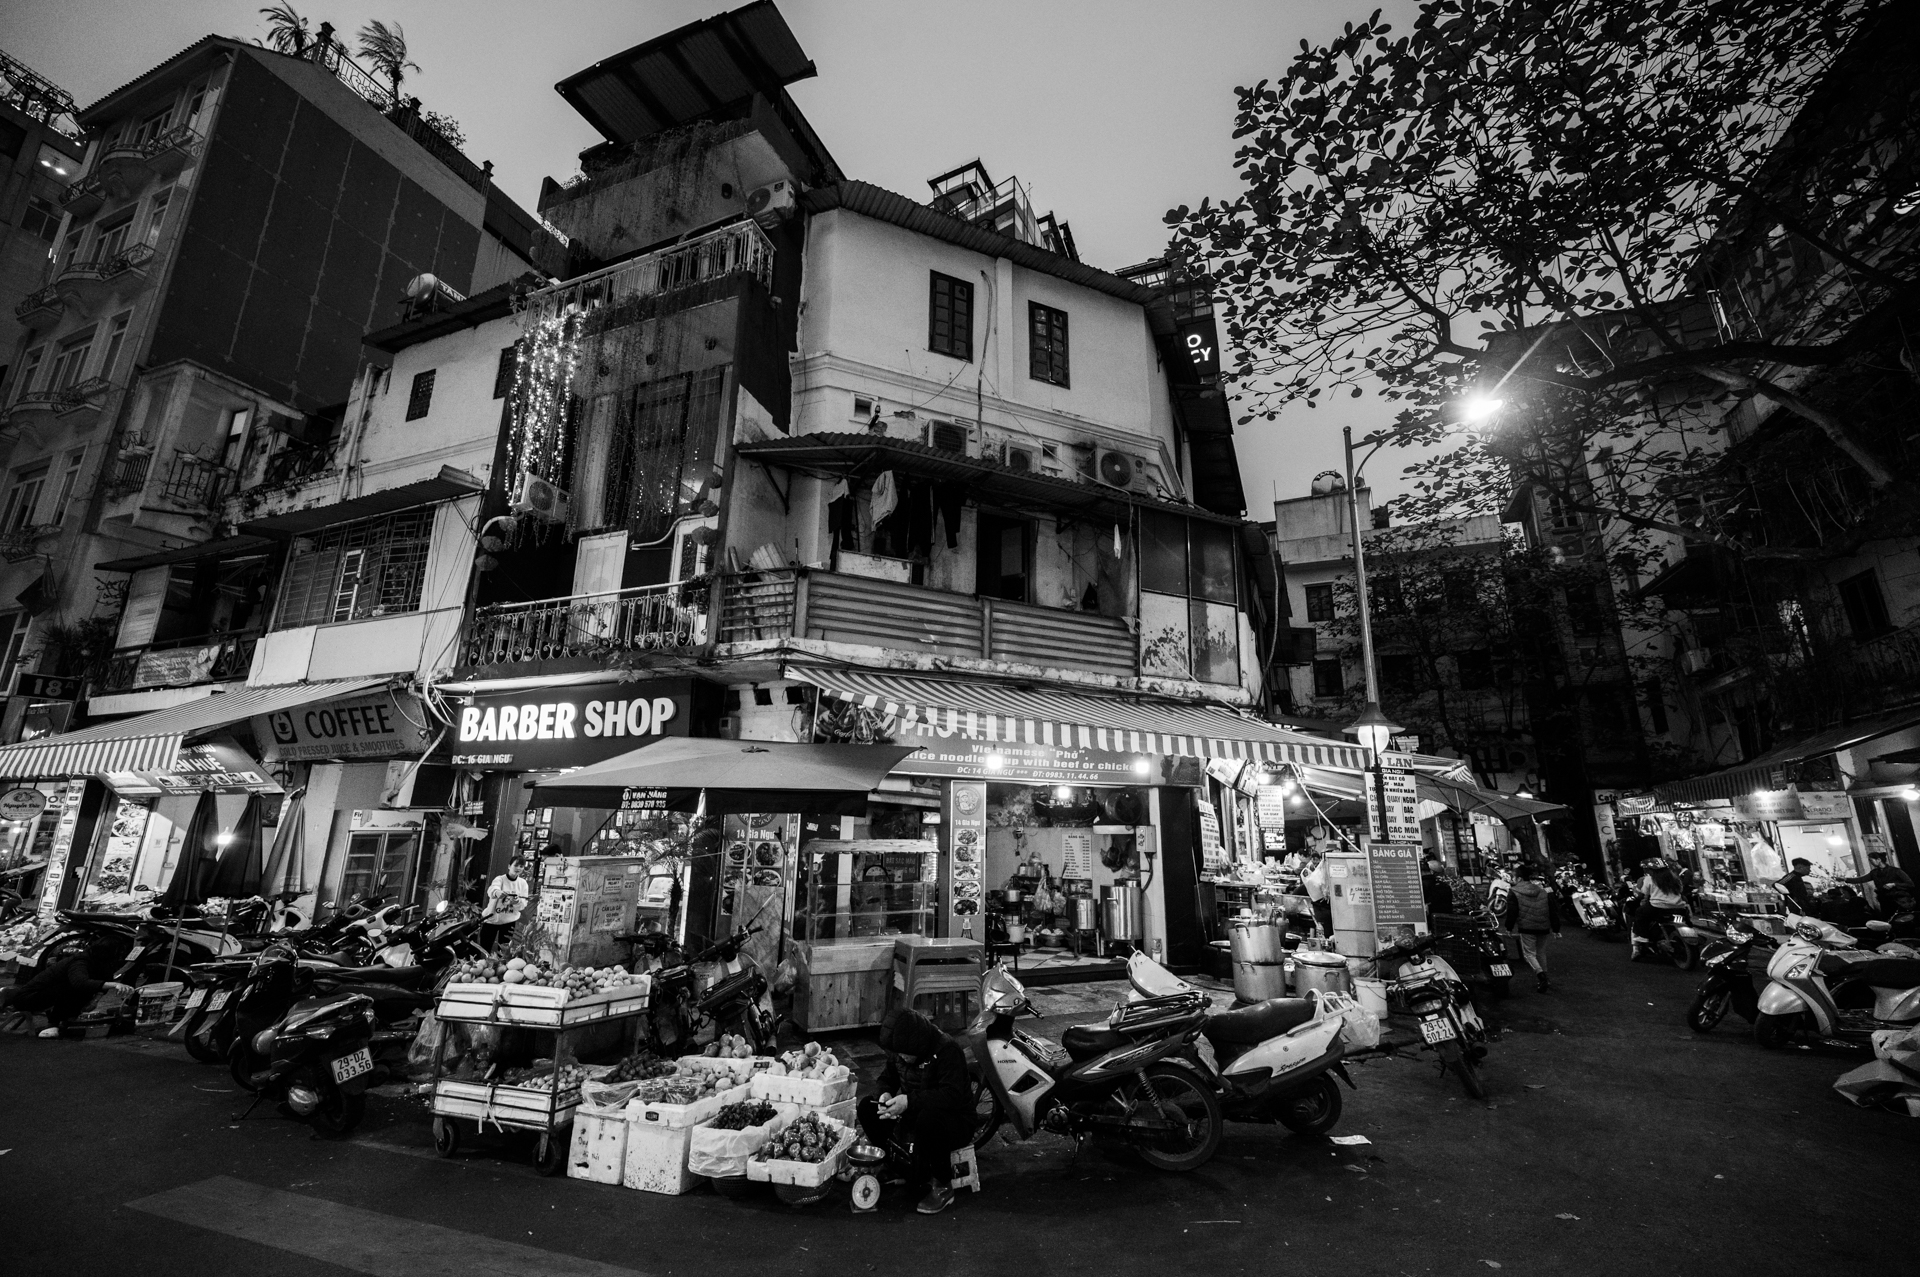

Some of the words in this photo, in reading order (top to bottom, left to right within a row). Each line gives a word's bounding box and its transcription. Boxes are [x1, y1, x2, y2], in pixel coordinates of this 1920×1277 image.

[304, 704, 395, 739] COFFEE
[459, 702, 577, 742] BARBER
[584, 697, 675, 738] SHOP
[280, 747, 297, 757] COLD
[331, 742, 350, 755] JUICE
[360, 739, 405, 751] SMOOTHIES
[477, 754, 491, 764] GIA
[1023, 758, 1050, 768] with
[1053, 760, 1079, 769] beef
[1083, 762, 1095, 770] or
[1386, 757, 1413, 768] LAN
[736, 829, 746, 839] 14
[1372, 847, 1396, 858] BẢNG
[1397, 848, 1413, 858] GIÁ
[1425, 1028, 1455, 1044] 502.24
[337, 1051, 366, 1070] 29-D2
[336, 1060, 372, 1082] 033.56
